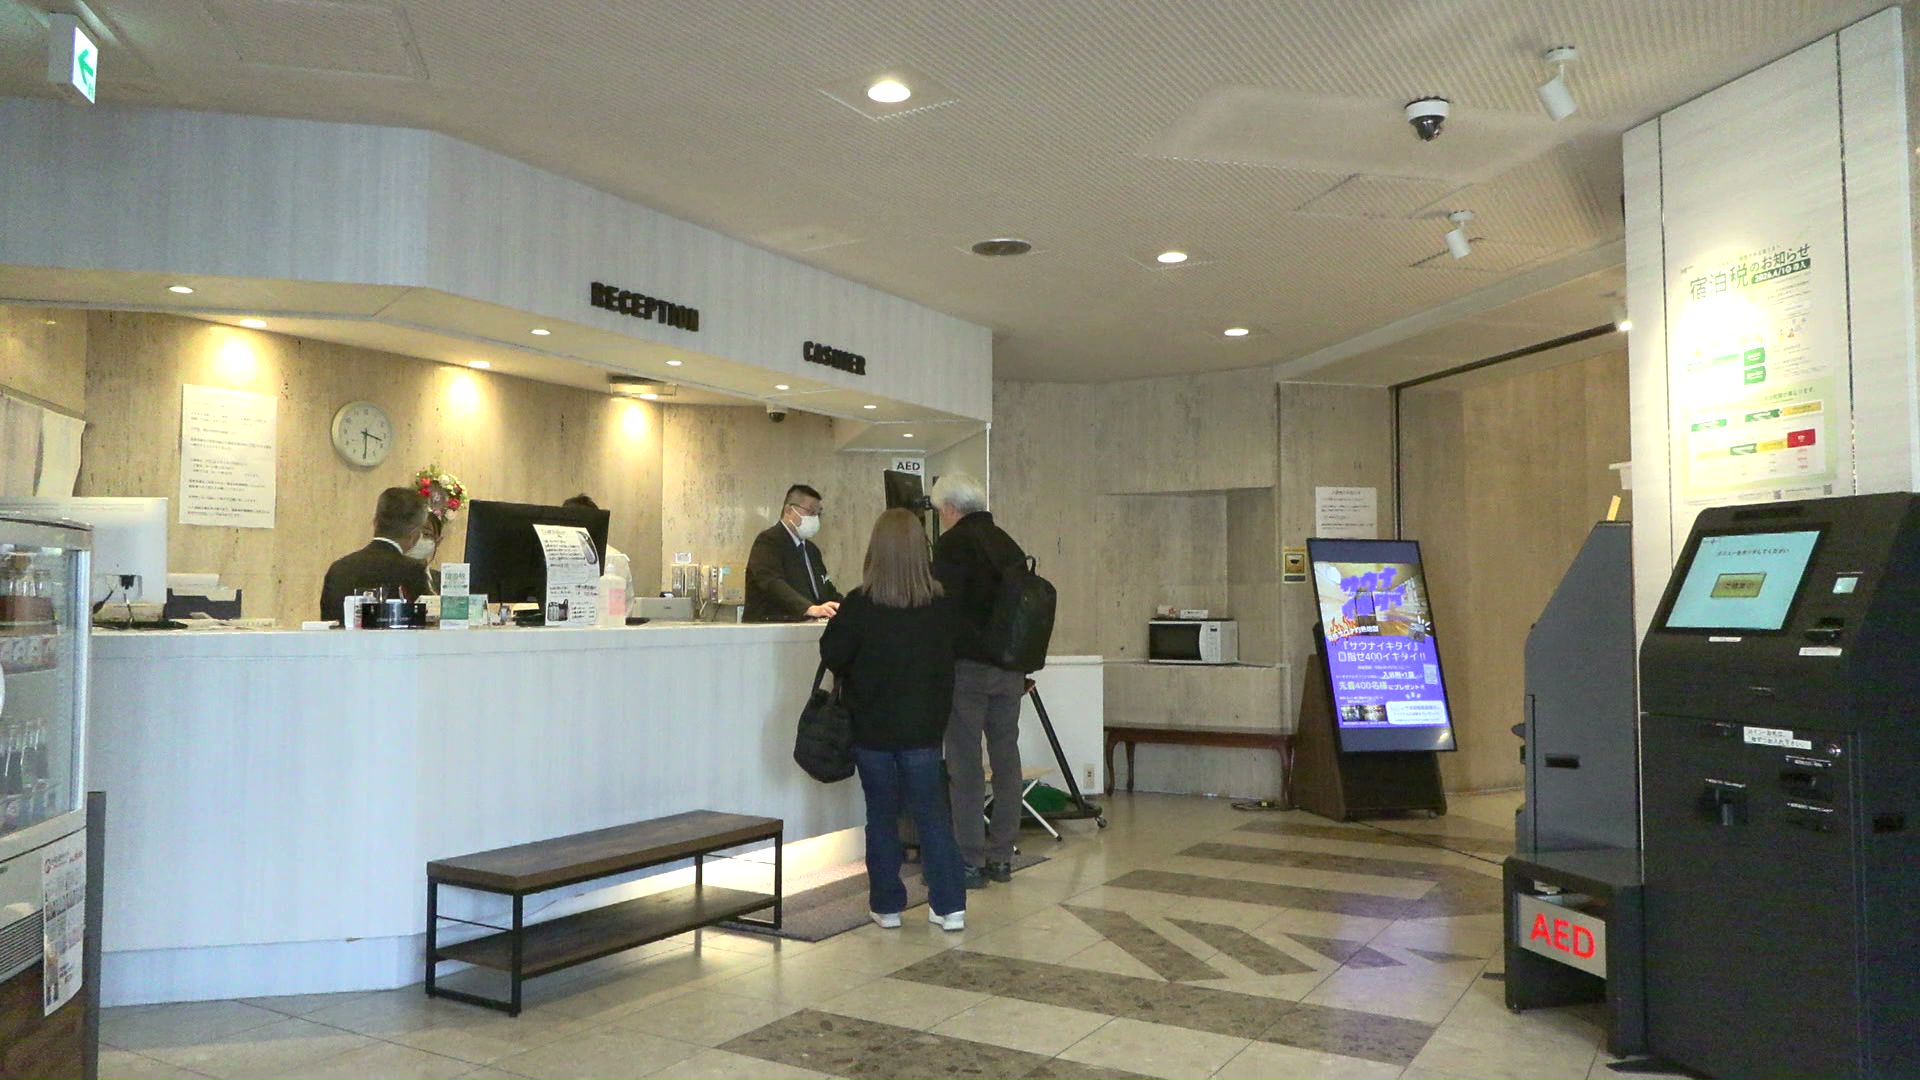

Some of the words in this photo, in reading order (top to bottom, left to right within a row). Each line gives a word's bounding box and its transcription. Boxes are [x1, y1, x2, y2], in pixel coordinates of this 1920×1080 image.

[1690, 244, 1811, 301] 宿泊税のお知らせ
[591, 281, 699, 332] RECEPTION
[803, 341, 866, 376] CASHIER
[896, 461, 921, 471] AED
[1530, 912, 1597, 959] AED
